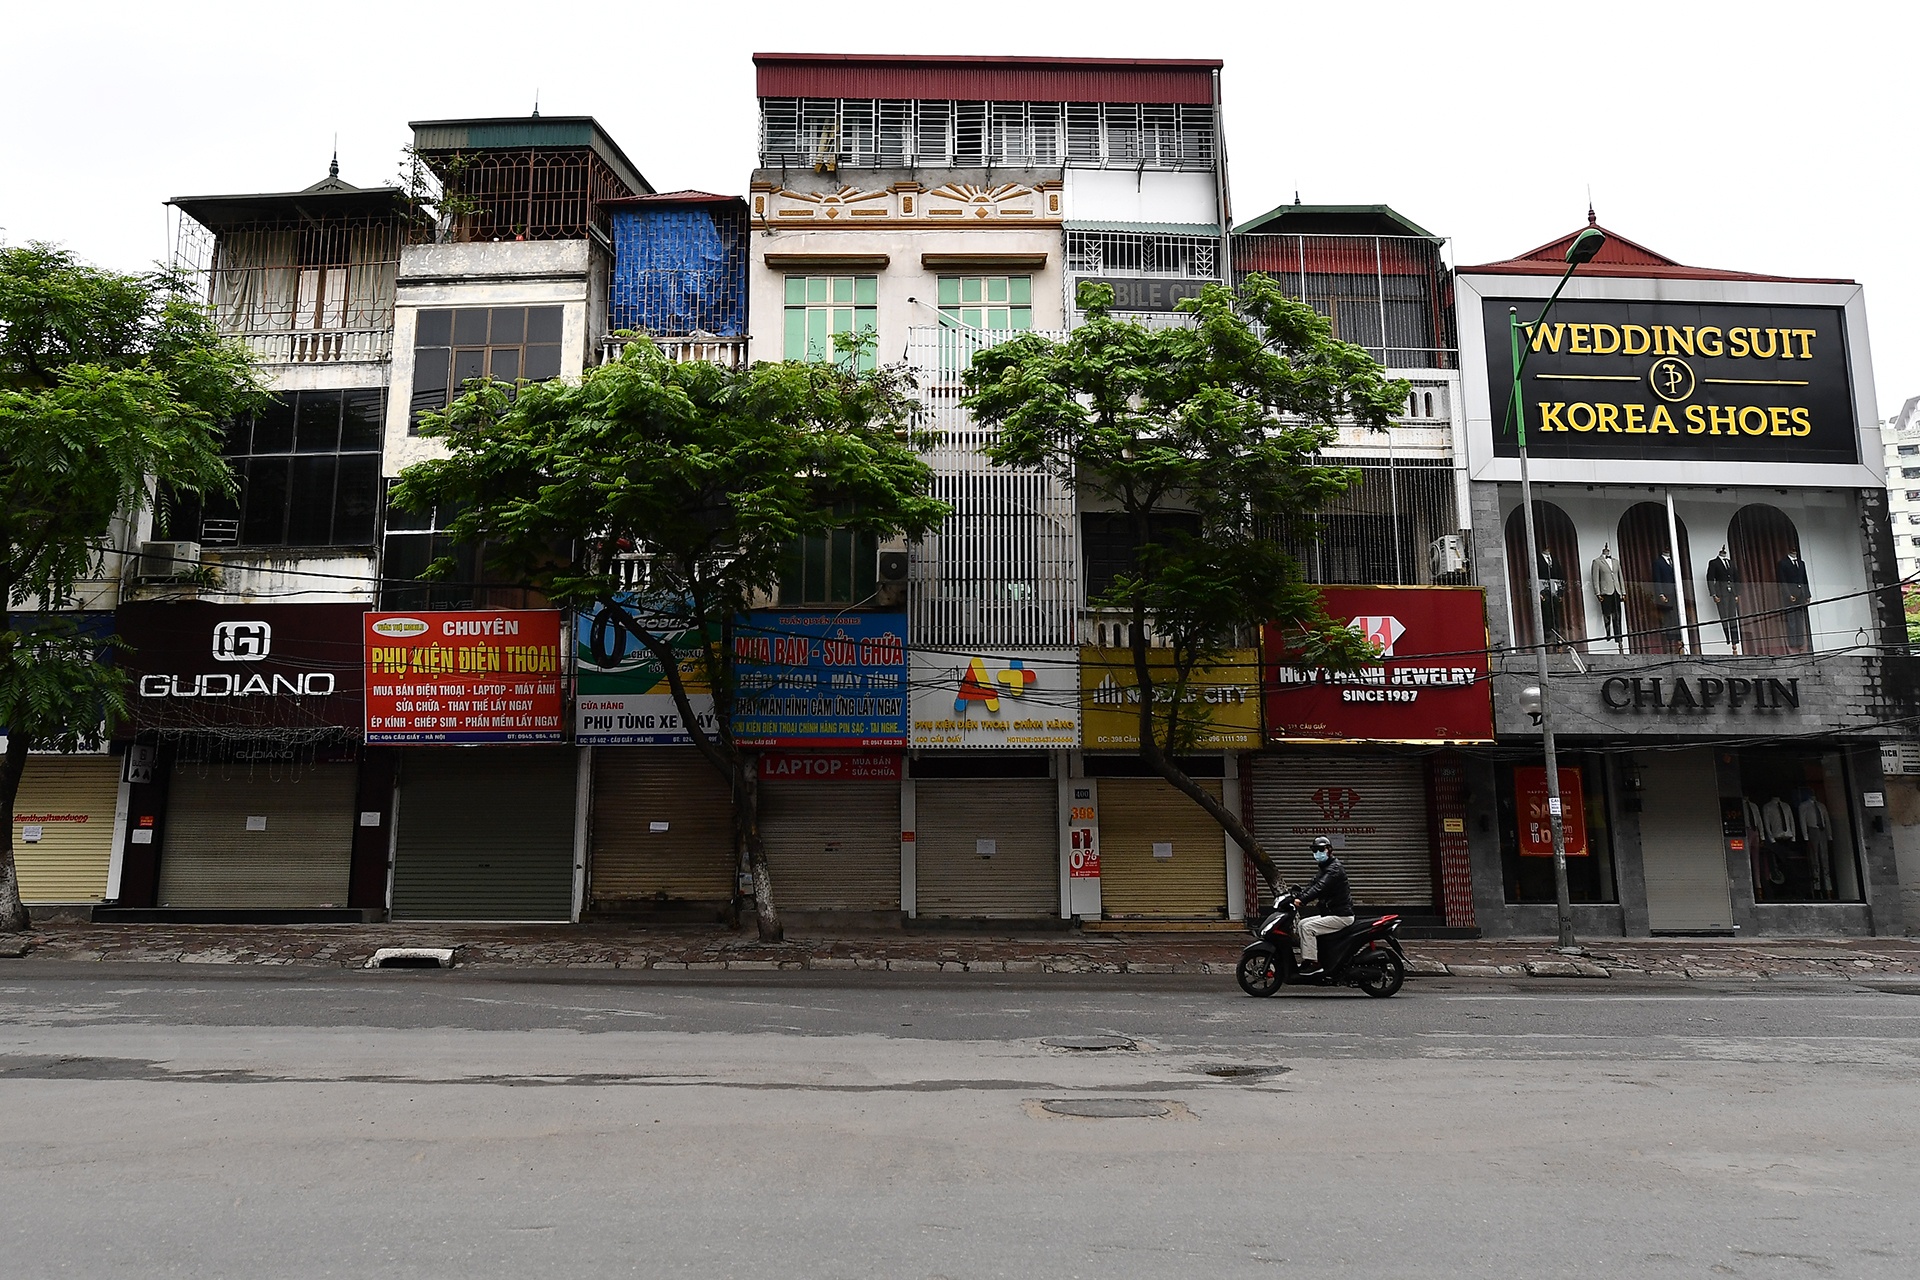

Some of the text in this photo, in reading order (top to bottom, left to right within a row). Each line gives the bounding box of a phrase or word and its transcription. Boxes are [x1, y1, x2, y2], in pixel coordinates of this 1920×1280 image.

[1169, 284, 1201, 307] CIT
[1522, 322, 1817, 359] WEDDING SUIT
[1538, 402, 1812, 437] KOREA SHOES
[443, 617, 519, 636] CHUYÊN
[631, 649, 658, 659] CHUY
[735, 636, 771, 666] MUA
[823, 628, 857, 666] SỬA
[860, 631, 904, 666] CHỮA
[372, 640, 556, 680] PHỤ KIỆN ĐIỆN THOẠI
[140, 672, 336, 697] GUDIANO
[831, 670, 862, 689] MÁY
[865, 670, 898, 689] TÍNH
[1280, 666, 1319, 684] HUY
[1391, 667, 1477, 686] JEWELRY
[373, 680, 556, 698] MUA BÁN ĐIỆN THOẠI LAPTOP MÁY ẢNH
[1126, 686, 1248, 703] MLE CITY
[1343, 690, 1418, 702] SINCE 1987
[1601, 677, 1800, 709] CHAPPIN
[396, 697, 533, 712] SỬA CHỮA THAY THẾ LẤY NGAY
[581, 701, 624, 710] CỬA HÀNG
[877, 698, 902, 716] NGAY
[371, 715, 382, 728] ÉP
[385, 715, 406, 728] KÍNH
[414, 715, 437, 727] GHÉP
[440, 717, 457, 727] SIM
[516, 712, 532, 727] LẤY
[535, 716, 558, 726] NGAY
[584, 712, 714, 732] PHỤ TÙNG XE ÁY
[870, 722, 880, 733] TAI
[766, 759, 842, 775] LAPTOP
[852, 758, 872, 766] MUA
[1076, 790, 1089, 798] 400
[1072, 806, 1095, 820] 398
[1529, 796, 1573, 819] SAE
[1530, 822, 1539, 832] UP
[1531, 833, 1540, 843] TO
